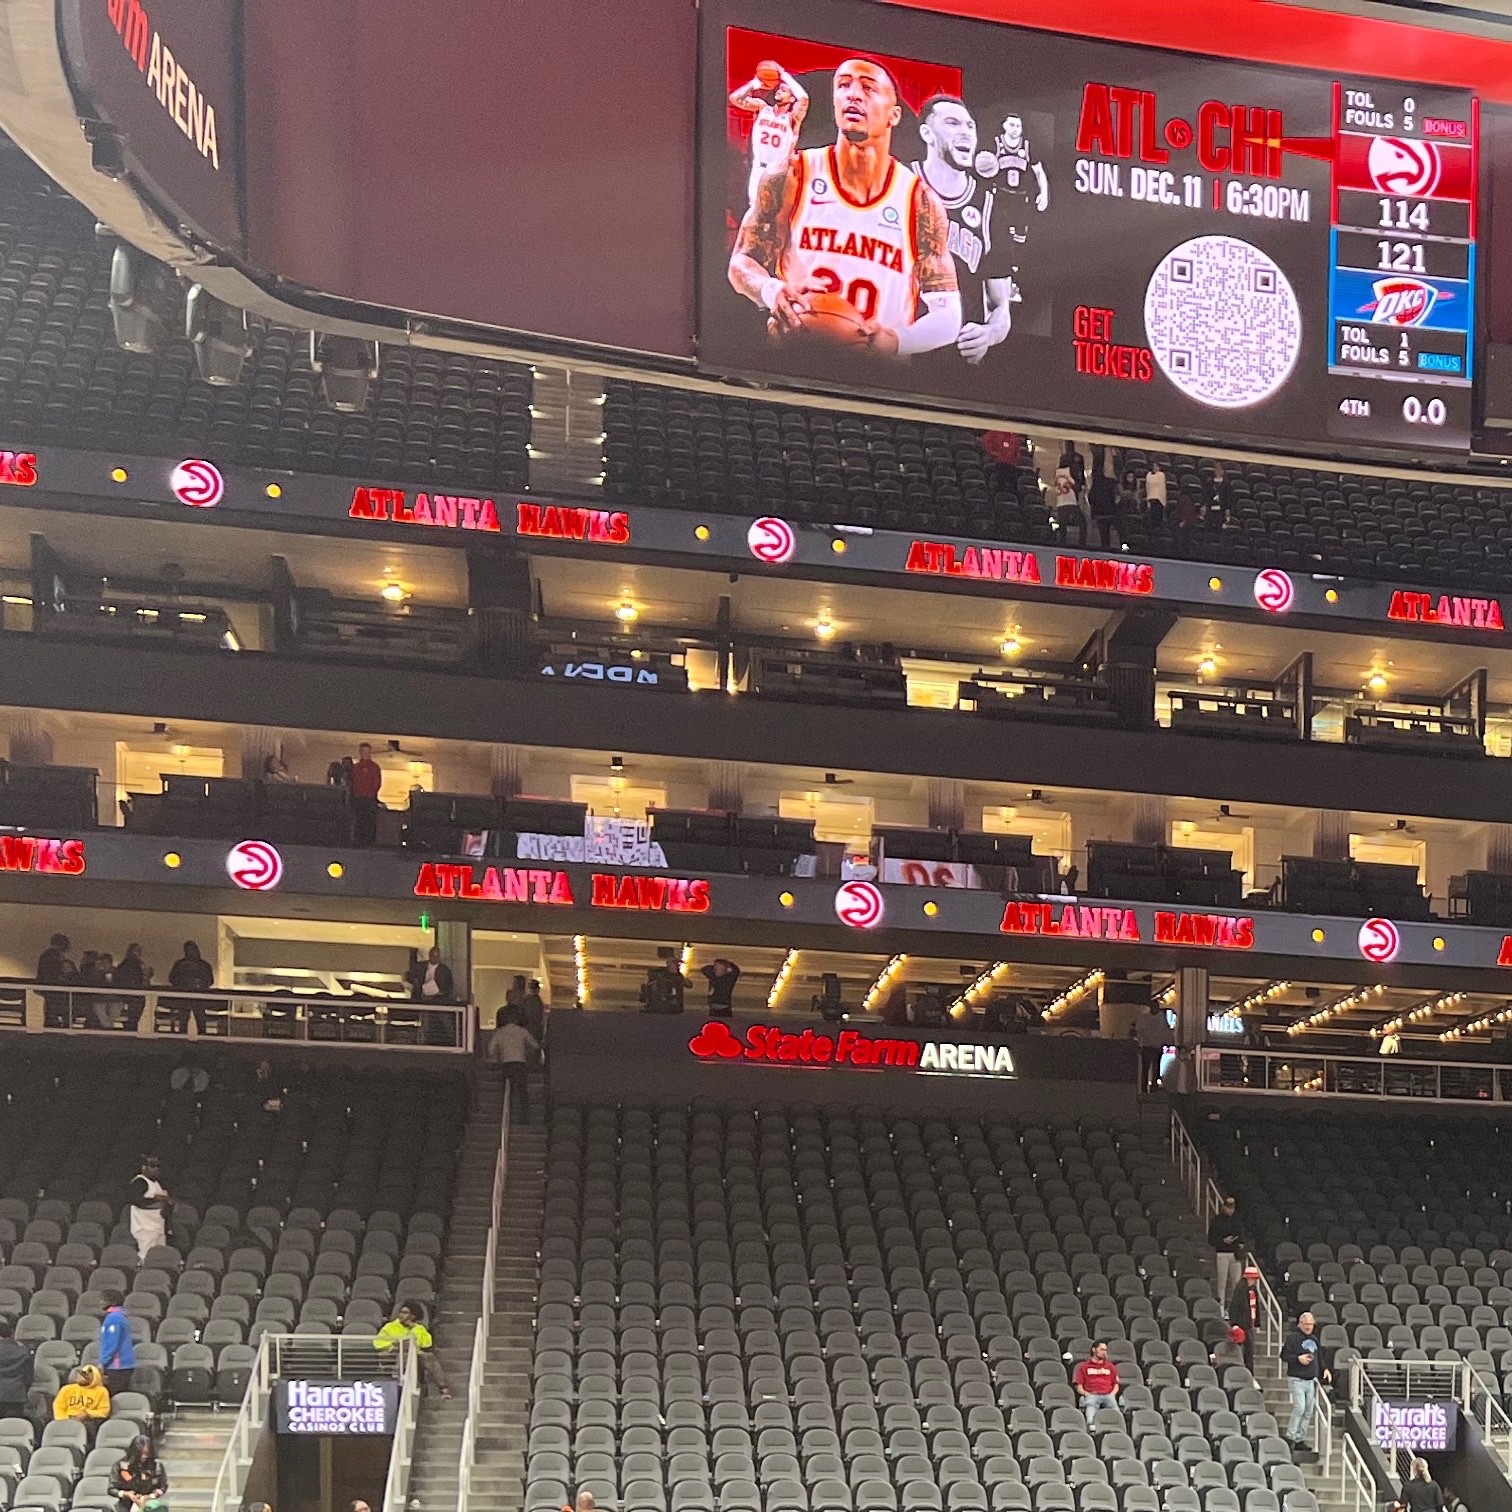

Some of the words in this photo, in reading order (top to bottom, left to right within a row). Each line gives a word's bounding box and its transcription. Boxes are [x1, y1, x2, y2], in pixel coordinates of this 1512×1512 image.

[147, 32, 218, 170] ARENA
[1345, 91, 1375, 108] TOL
[1404, 97, 1415, 112] 0
[1075, 83, 1168, 164] ATL
[1198, 100, 1283, 180] CHI
[1345, 109, 1394, 129] FOULS
[1404, 116, 1414, 130] 5
[1424, 121, 1464, 134] BONUS
[760, 131, 781, 148] 20
[1075, 159, 1123, 197] SUN.
[1131, 167, 1180, 205] DEC.
[1183, 175, 1201, 208] 11
[1226, 181, 1309, 222] 6:30PM
[1378, 198, 1430, 230] 114
[799, 227, 904, 273] ATLANTA
[1378, 241, 1426, 273] 121
[1073, 305, 1115, 341] GET
[1341, 326, 1370, 344] TOL
[1400, 333, 1409, 348] 1
[1073, 340, 1153, 381] TICKETS
[1341, 345, 1389, 363] FOULS
[1399, 351, 1410, 366] 5
[1420, 354, 1459, 369] BONUS
[1339, 399, 1371, 417] 4TH
[1403, 396, 1447, 426] 0.0
[348, 486, 501, 532] ATLANTA
[516, 503, 630, 545] HAWKS
[905, 541, 1042, 585] ATLANTA
[1054, 555, 1155, 596] HAWKS
[1387, 590, 1505, 630] ATLANTA
[0, 836, 86, 875] WKS
[413, 863, 574, 905] ATLANTA
[591, 873, 711, 913] HAWKS
[999, 901, 1142, 942] ATLANTA
[1153, 911, 1254, 949] HAWKS
[919, 1042, 1015, 1073] ARENA
[288, 1380, 385, 1407] Harrah's
[288, 1407, 384, 1423] CHEROKEE
[288, 1423, 346, 1432] CASINOS
[349, 1423, 385, 1432] CLUB
[1420, 1440, 1446, 1449] CLUB
